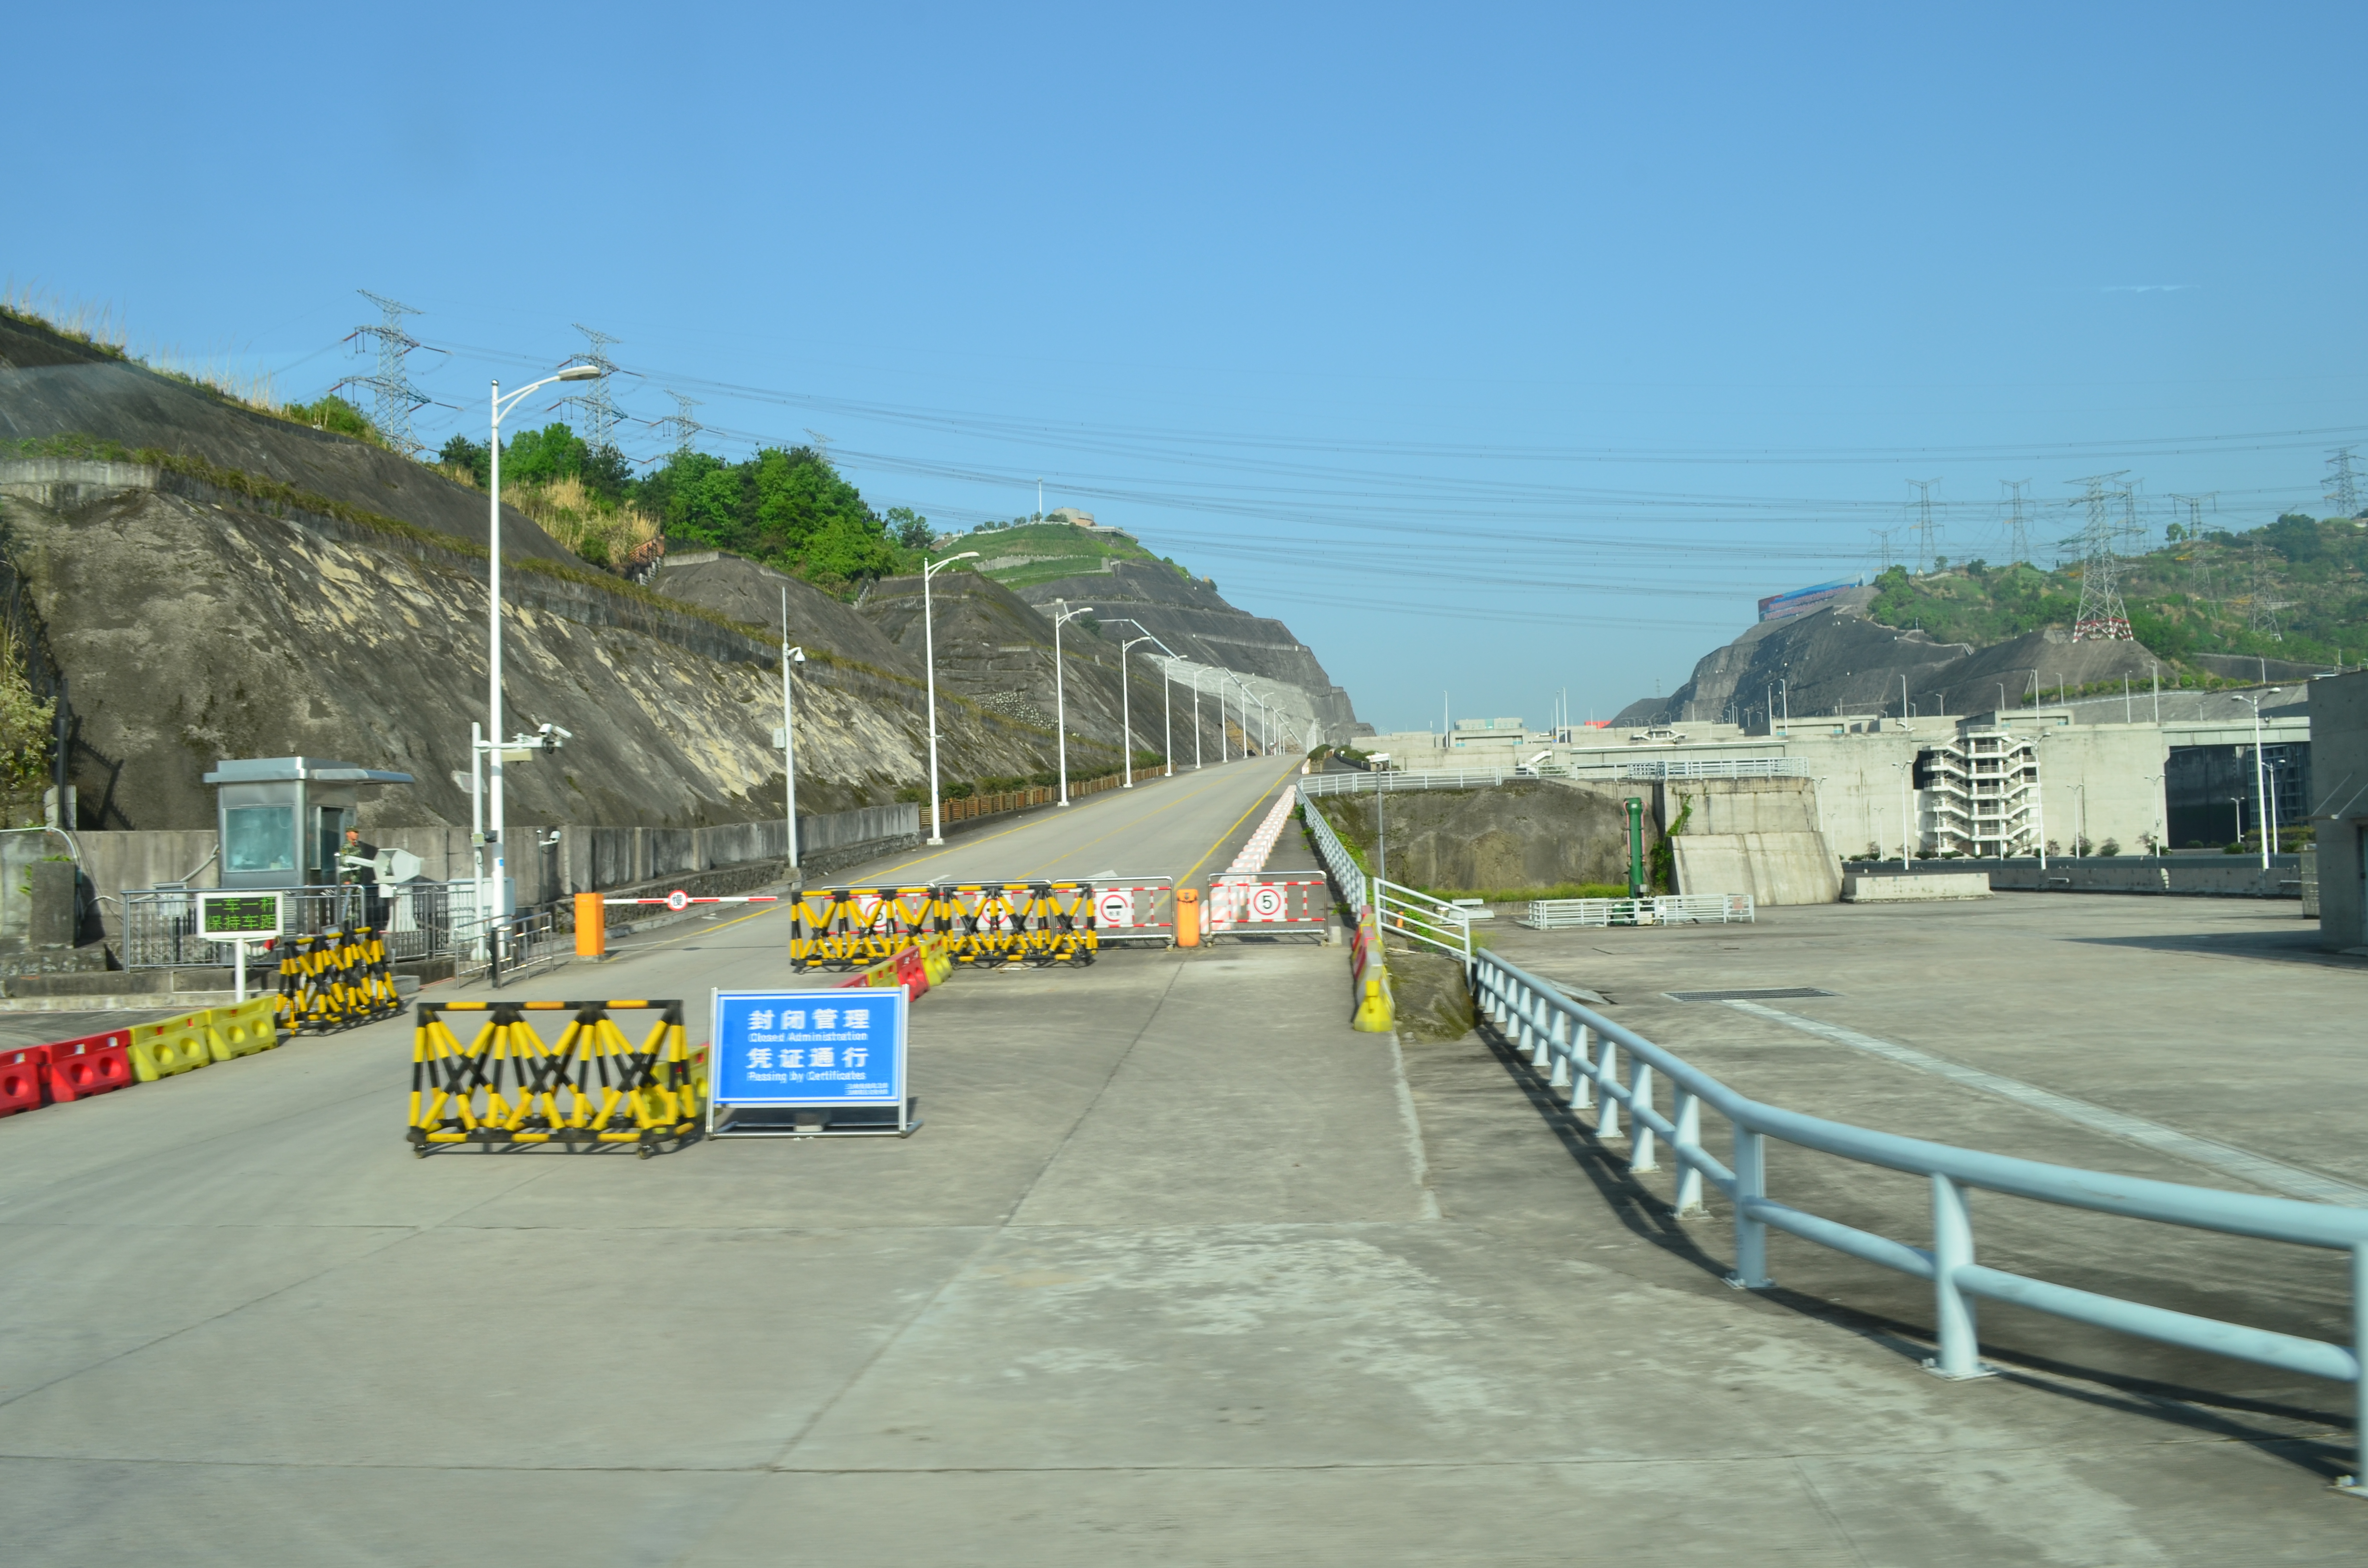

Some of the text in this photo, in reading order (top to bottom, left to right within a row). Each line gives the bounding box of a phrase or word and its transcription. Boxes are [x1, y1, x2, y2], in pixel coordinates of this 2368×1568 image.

[206, 896, 276, 913] 一车一杆
[672, 894, 683, 906] 慢
[1262, 895, 1273, 909] 5
[206, 914, 276, 931] 保持车距
[747, 1008, 870, 1030] 封闭管理
[748, 1031, 868, 1042] Closed Administration
[746, 1047, 870, 1069] 凭证通行
[747, 1070, 867, 1084] Passing by Certificates
